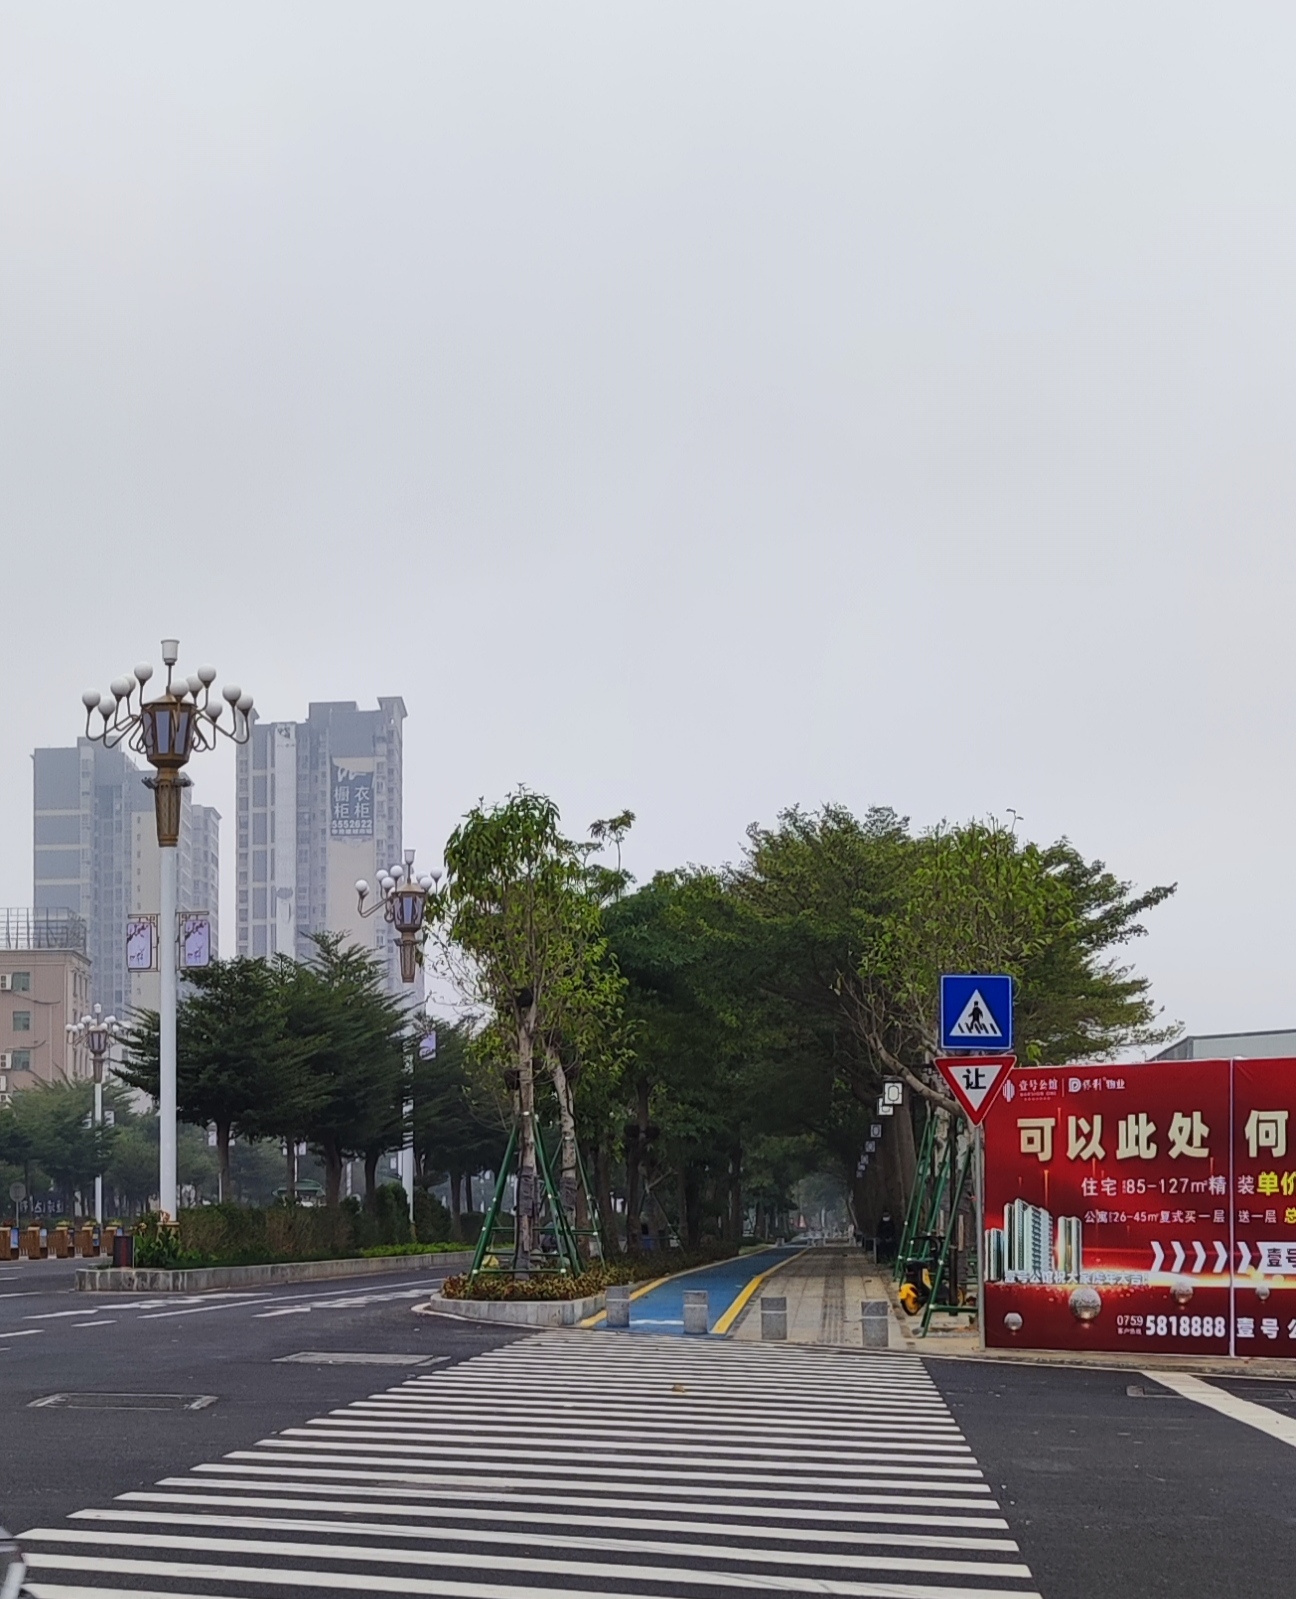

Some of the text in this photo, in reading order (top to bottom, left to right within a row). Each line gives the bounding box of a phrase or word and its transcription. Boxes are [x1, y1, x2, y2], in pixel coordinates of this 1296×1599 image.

[962, 1067, 987, 1090] 让
[1016, 1109, 1289, 1162] 可以此处 何
[1116, 1314, 1226, 1338] 0759 5818888
